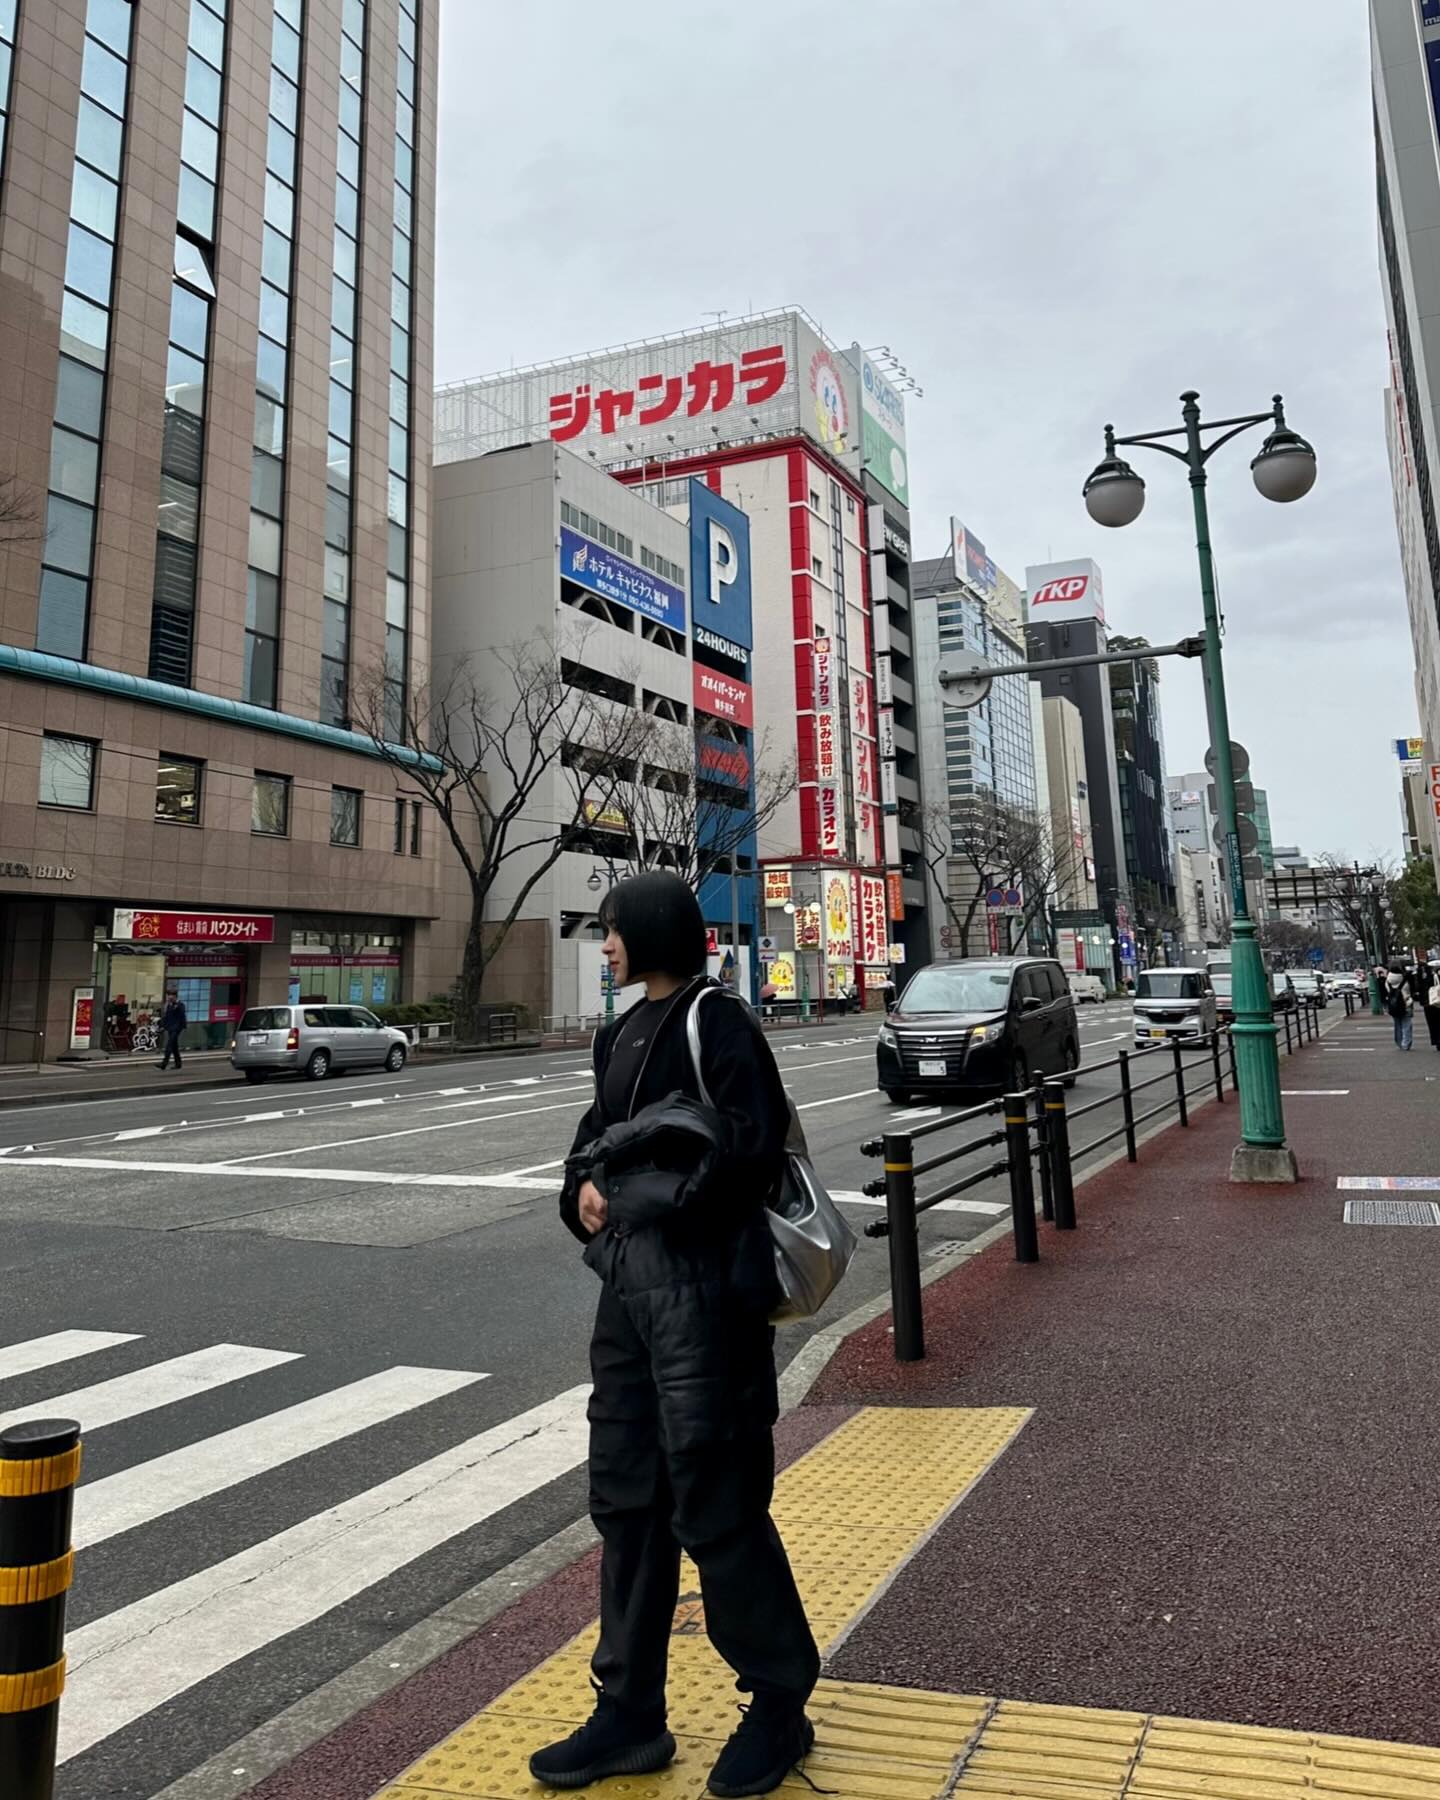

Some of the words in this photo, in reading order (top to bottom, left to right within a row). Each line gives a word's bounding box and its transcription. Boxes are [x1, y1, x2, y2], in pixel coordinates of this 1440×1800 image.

[550, 345, 786, 442] ジャンカラ
[708, 517, 738, 604] P
[1038, 578, 1085, 601] TKP
[697, 627, 748, 665] 24HOURS
[819, 655, 829, 706] ジャンカラ
[819, 714, 832, 777] 飲み放題付
[822, 787, 836, 845] カラオケ
[36, 864, 77, 881] BLDG
[209, 921, 259, 937] ハウスメイト
[863, 879, 875, 961] カラオケ
[827, 939, 851, 956] ジャンカラ
